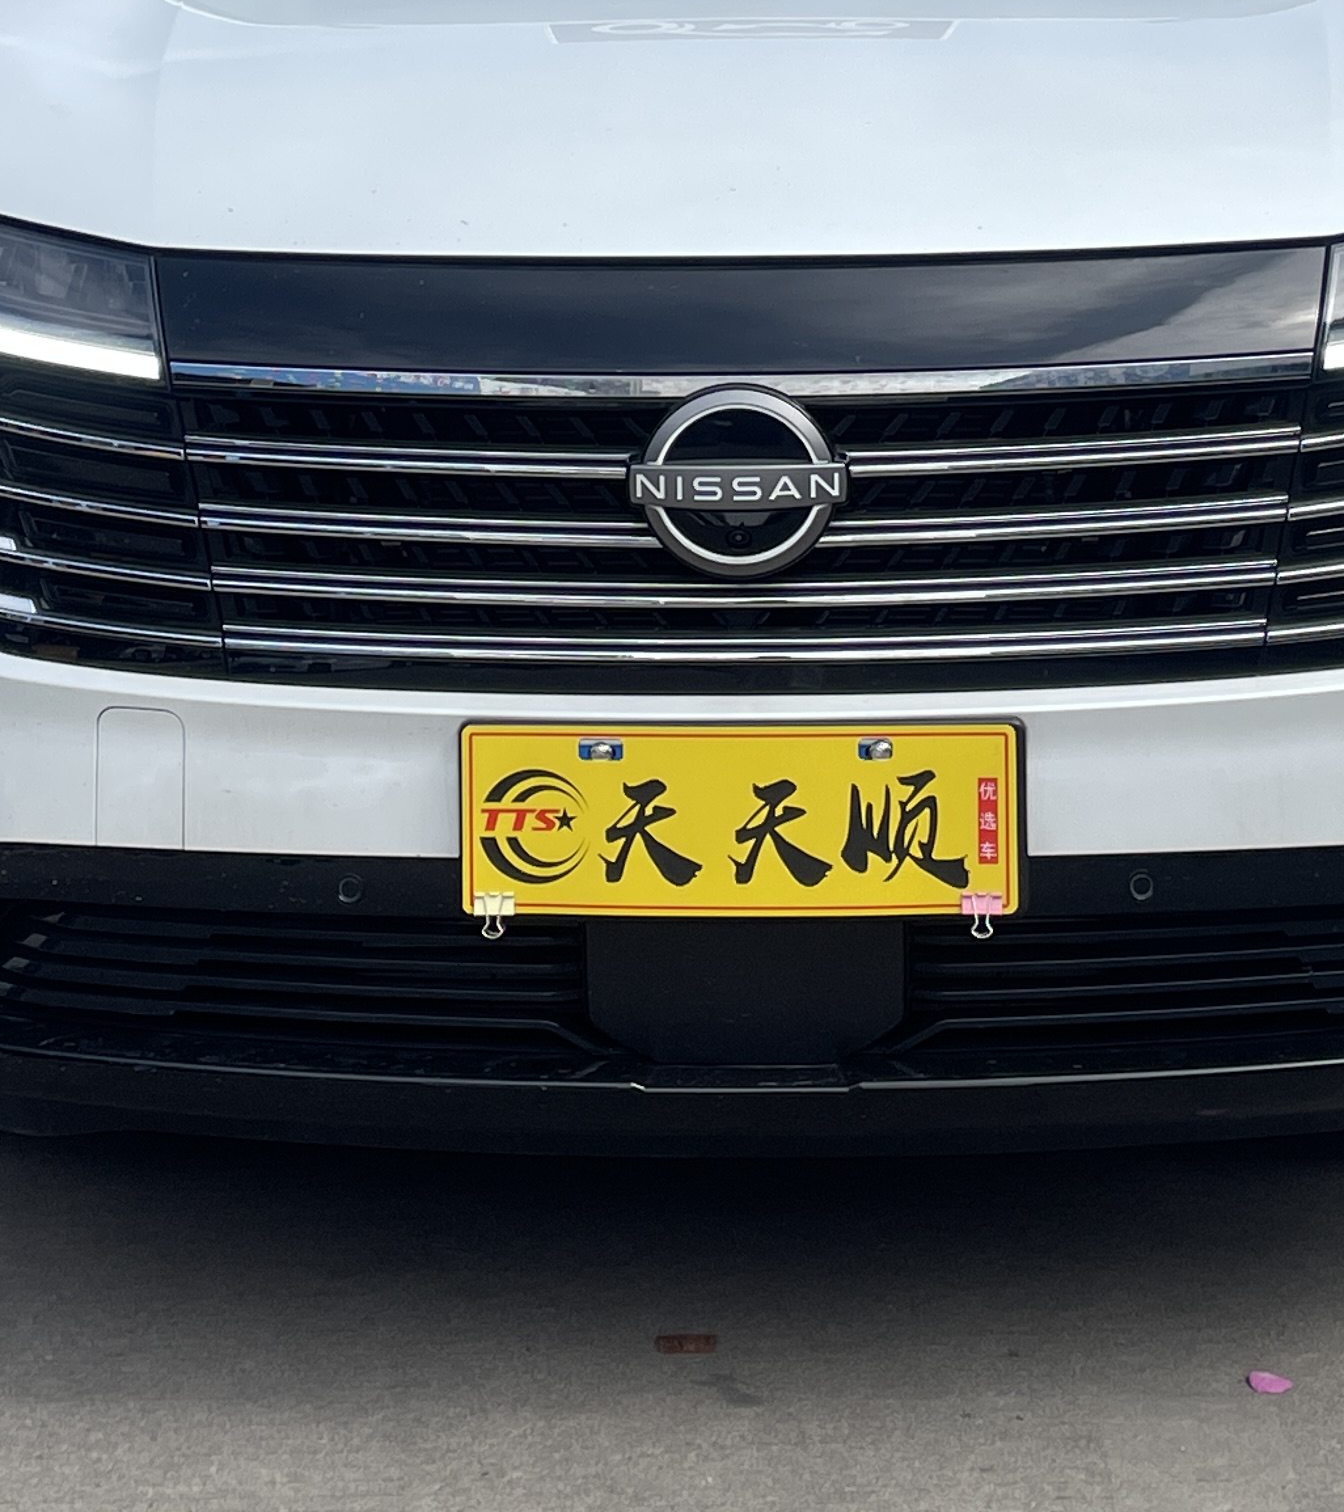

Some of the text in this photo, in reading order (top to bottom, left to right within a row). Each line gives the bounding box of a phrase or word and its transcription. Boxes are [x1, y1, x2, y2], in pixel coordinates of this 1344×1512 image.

[635, 471, 840, 502] NISSAN
[480, 808, 557, 832] TTS
[597, 769, 971, 888] 天天顺
[978, 781, 997, 861] 优选车
